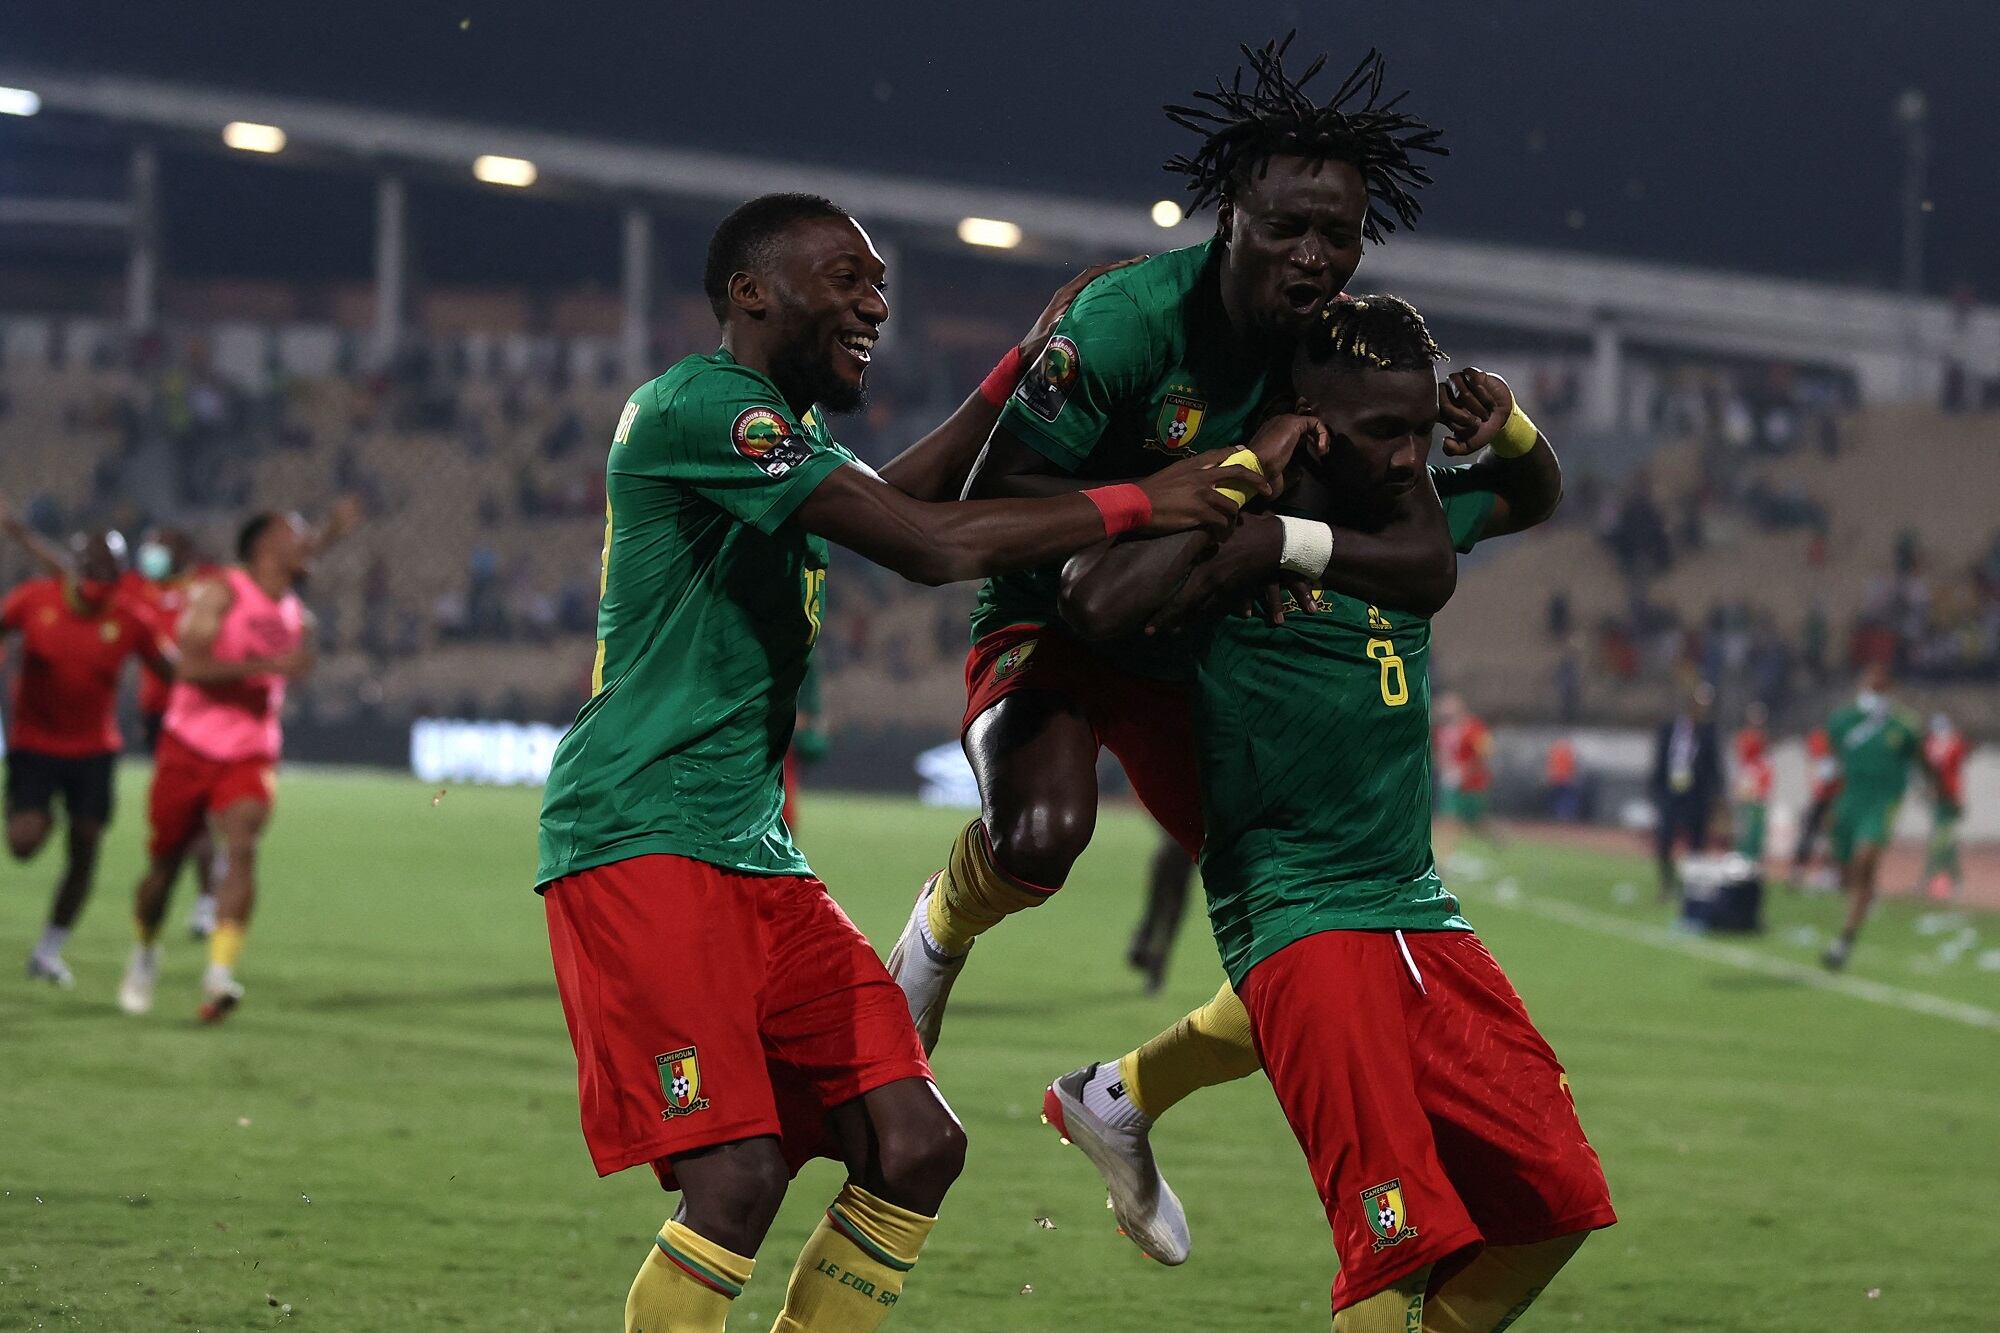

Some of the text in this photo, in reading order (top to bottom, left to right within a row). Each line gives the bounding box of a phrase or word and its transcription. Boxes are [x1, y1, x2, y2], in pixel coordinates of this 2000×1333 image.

[737, 411, 774, 441] CAMEROUN 2021
[1366, 637, 1409, 707] 8
[659, 1050, 693, 1064] CAMEROUN
[1364, 1182, 1397, 1199] CAMEROUN
[815, 1258, 899, 1307] LE COQ SP
